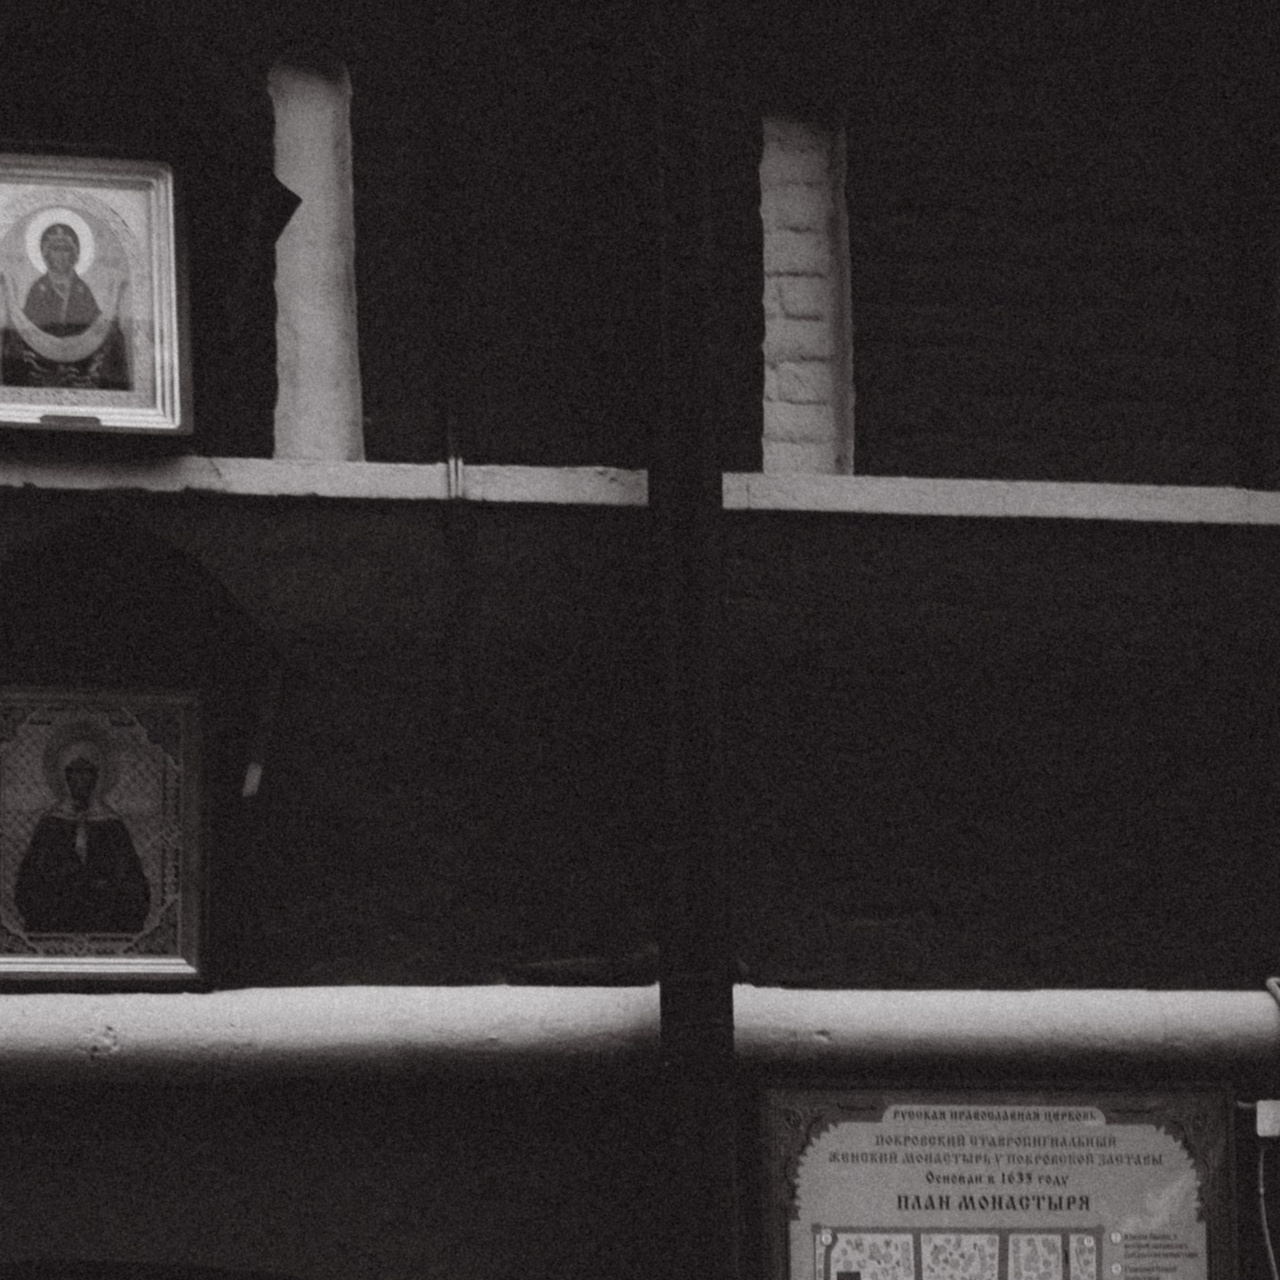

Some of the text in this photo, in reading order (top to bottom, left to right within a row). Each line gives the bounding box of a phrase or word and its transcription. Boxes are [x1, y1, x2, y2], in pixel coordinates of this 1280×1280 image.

[893, 1109, 1096, 1124] РУССКАЯ ПРАВОСЛАВНАЯ ЦЕРКОВЬ
[875, 1134, 1116, 1148] ПОКРОВСКИЙ СТАВРОПИГИАЛЬНЫЙ
[828, 1151, 898, 1164] ЖЕНСКИЙ
[901, 1152, 991, 1165] МОНАСТЫРЬ
[1007, 1153, 1094, 1166] ПОКРОВСКОЙ
[1098, 1154, 1163, 1167] ЗАСТАВЫ
[926, 1170, 983, 1185] Основан
[1001, 1172, 1033, 1185] 1635
[1038, 1175, 1069, 1187] году
[897, 1194, 1091, 1211] ПЛАН МОНАСТЫРЯ
